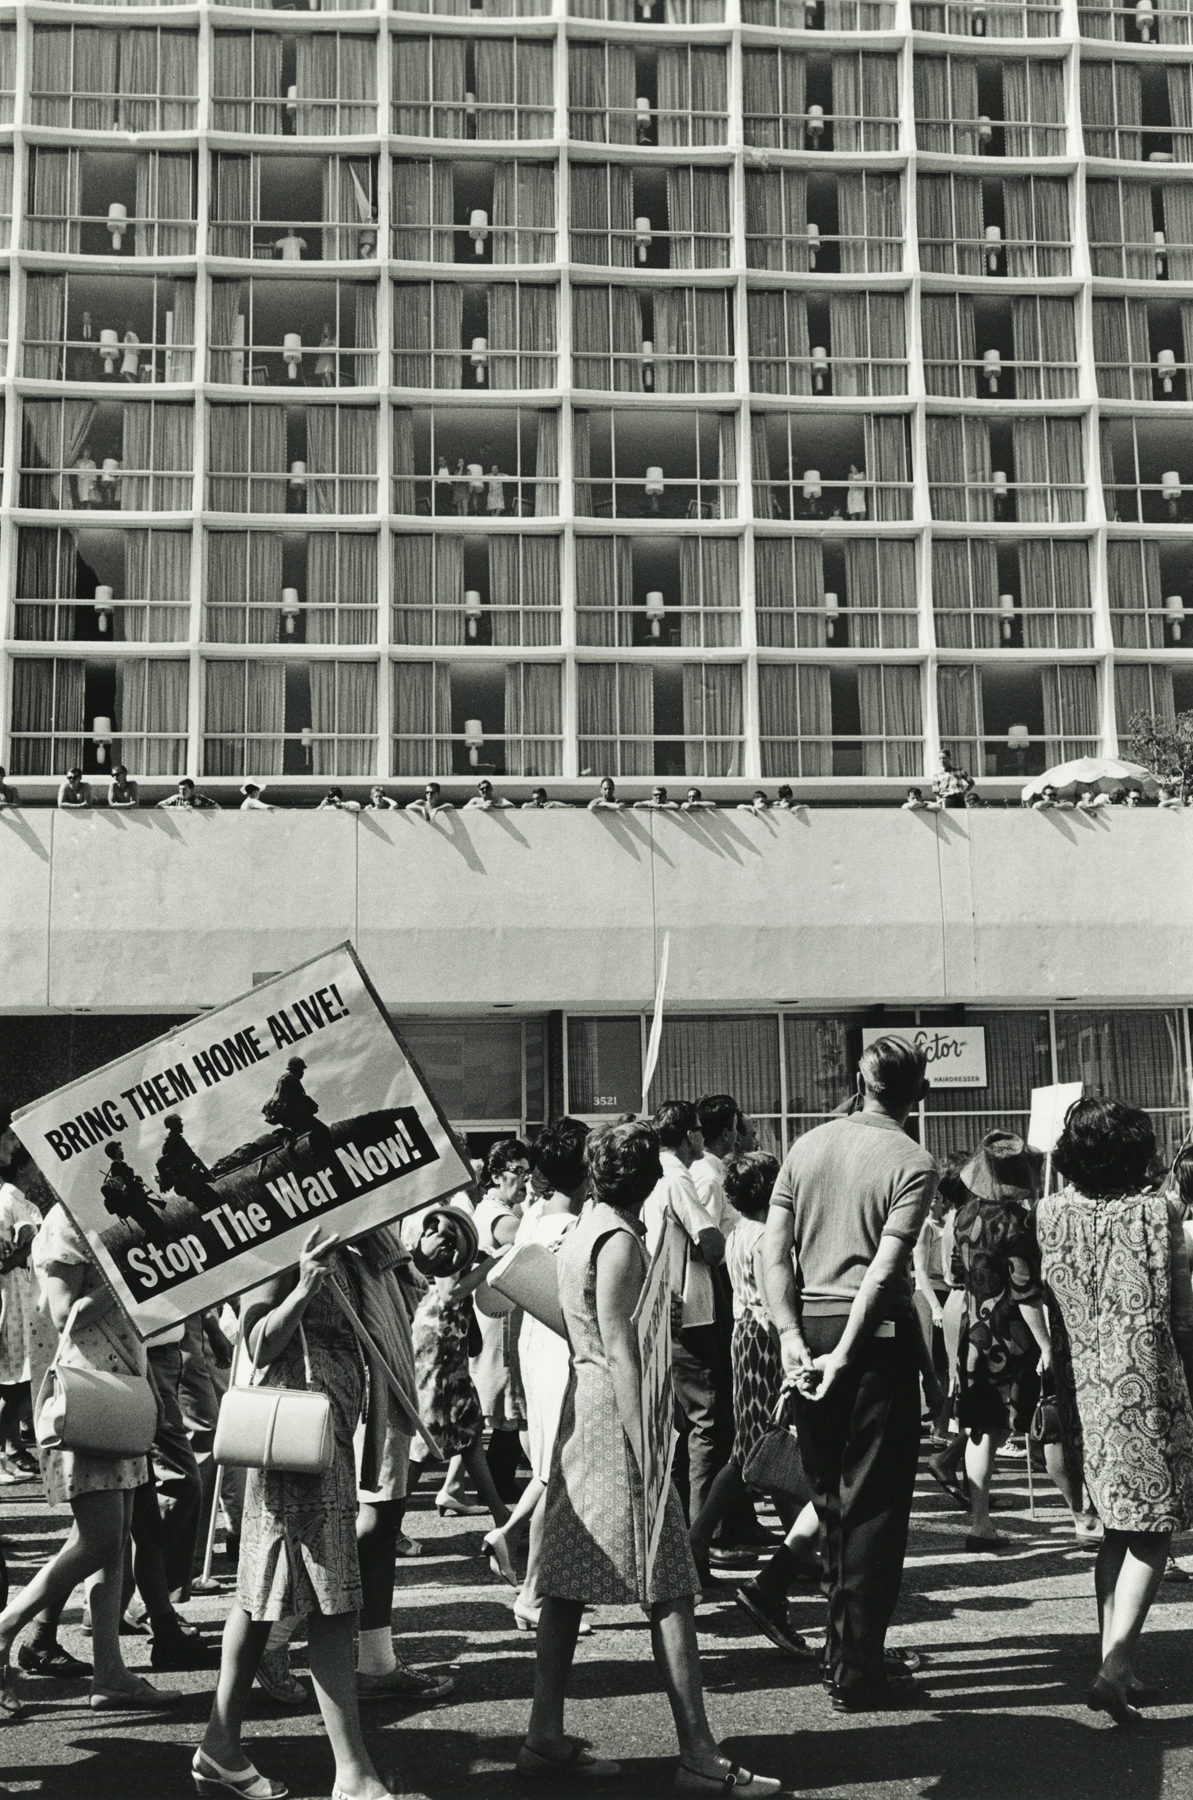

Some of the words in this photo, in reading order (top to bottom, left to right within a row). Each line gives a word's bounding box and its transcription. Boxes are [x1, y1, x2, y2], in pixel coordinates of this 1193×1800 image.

[44, 1100, 128, 1161] BRING
[120, 1062, 197, 1120] THEM
[191, 1026, 270, 1088] HOME
[265, 983, 350, 1050] ALIVE!
[913, 1030, 962, 1062] ctor
[593, 1096, 617, 1106] 3521
[126, 1233, 208, 1289] Stop
[201, 1203, 272, 1250] The
[265, 1165, 337, 1219] War
[334, 1119, 422, 1189] Now!
